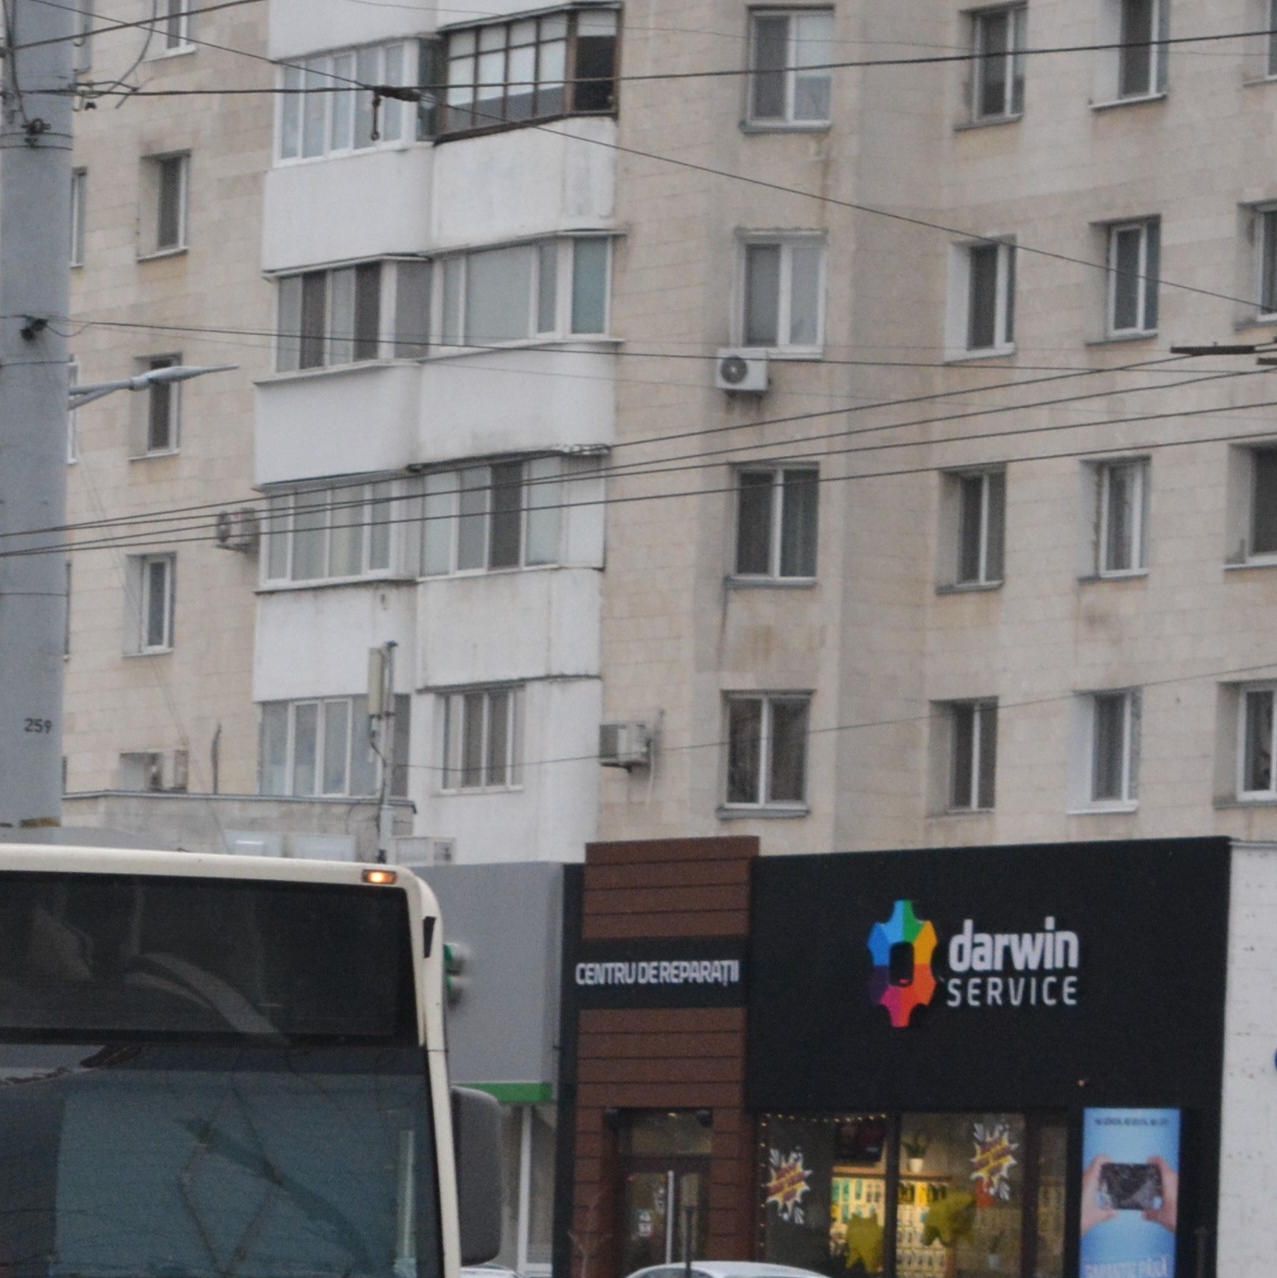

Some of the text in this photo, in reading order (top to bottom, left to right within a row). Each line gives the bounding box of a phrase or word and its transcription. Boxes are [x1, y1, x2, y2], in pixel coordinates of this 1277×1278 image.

[24, 718, 53, 734] 259
[949, 916, 1079, 972] darwin
[575, 960, 740, 987] CENTRU DE REPARAȚII
[947, 976, 1079, 1007] SERVICE
